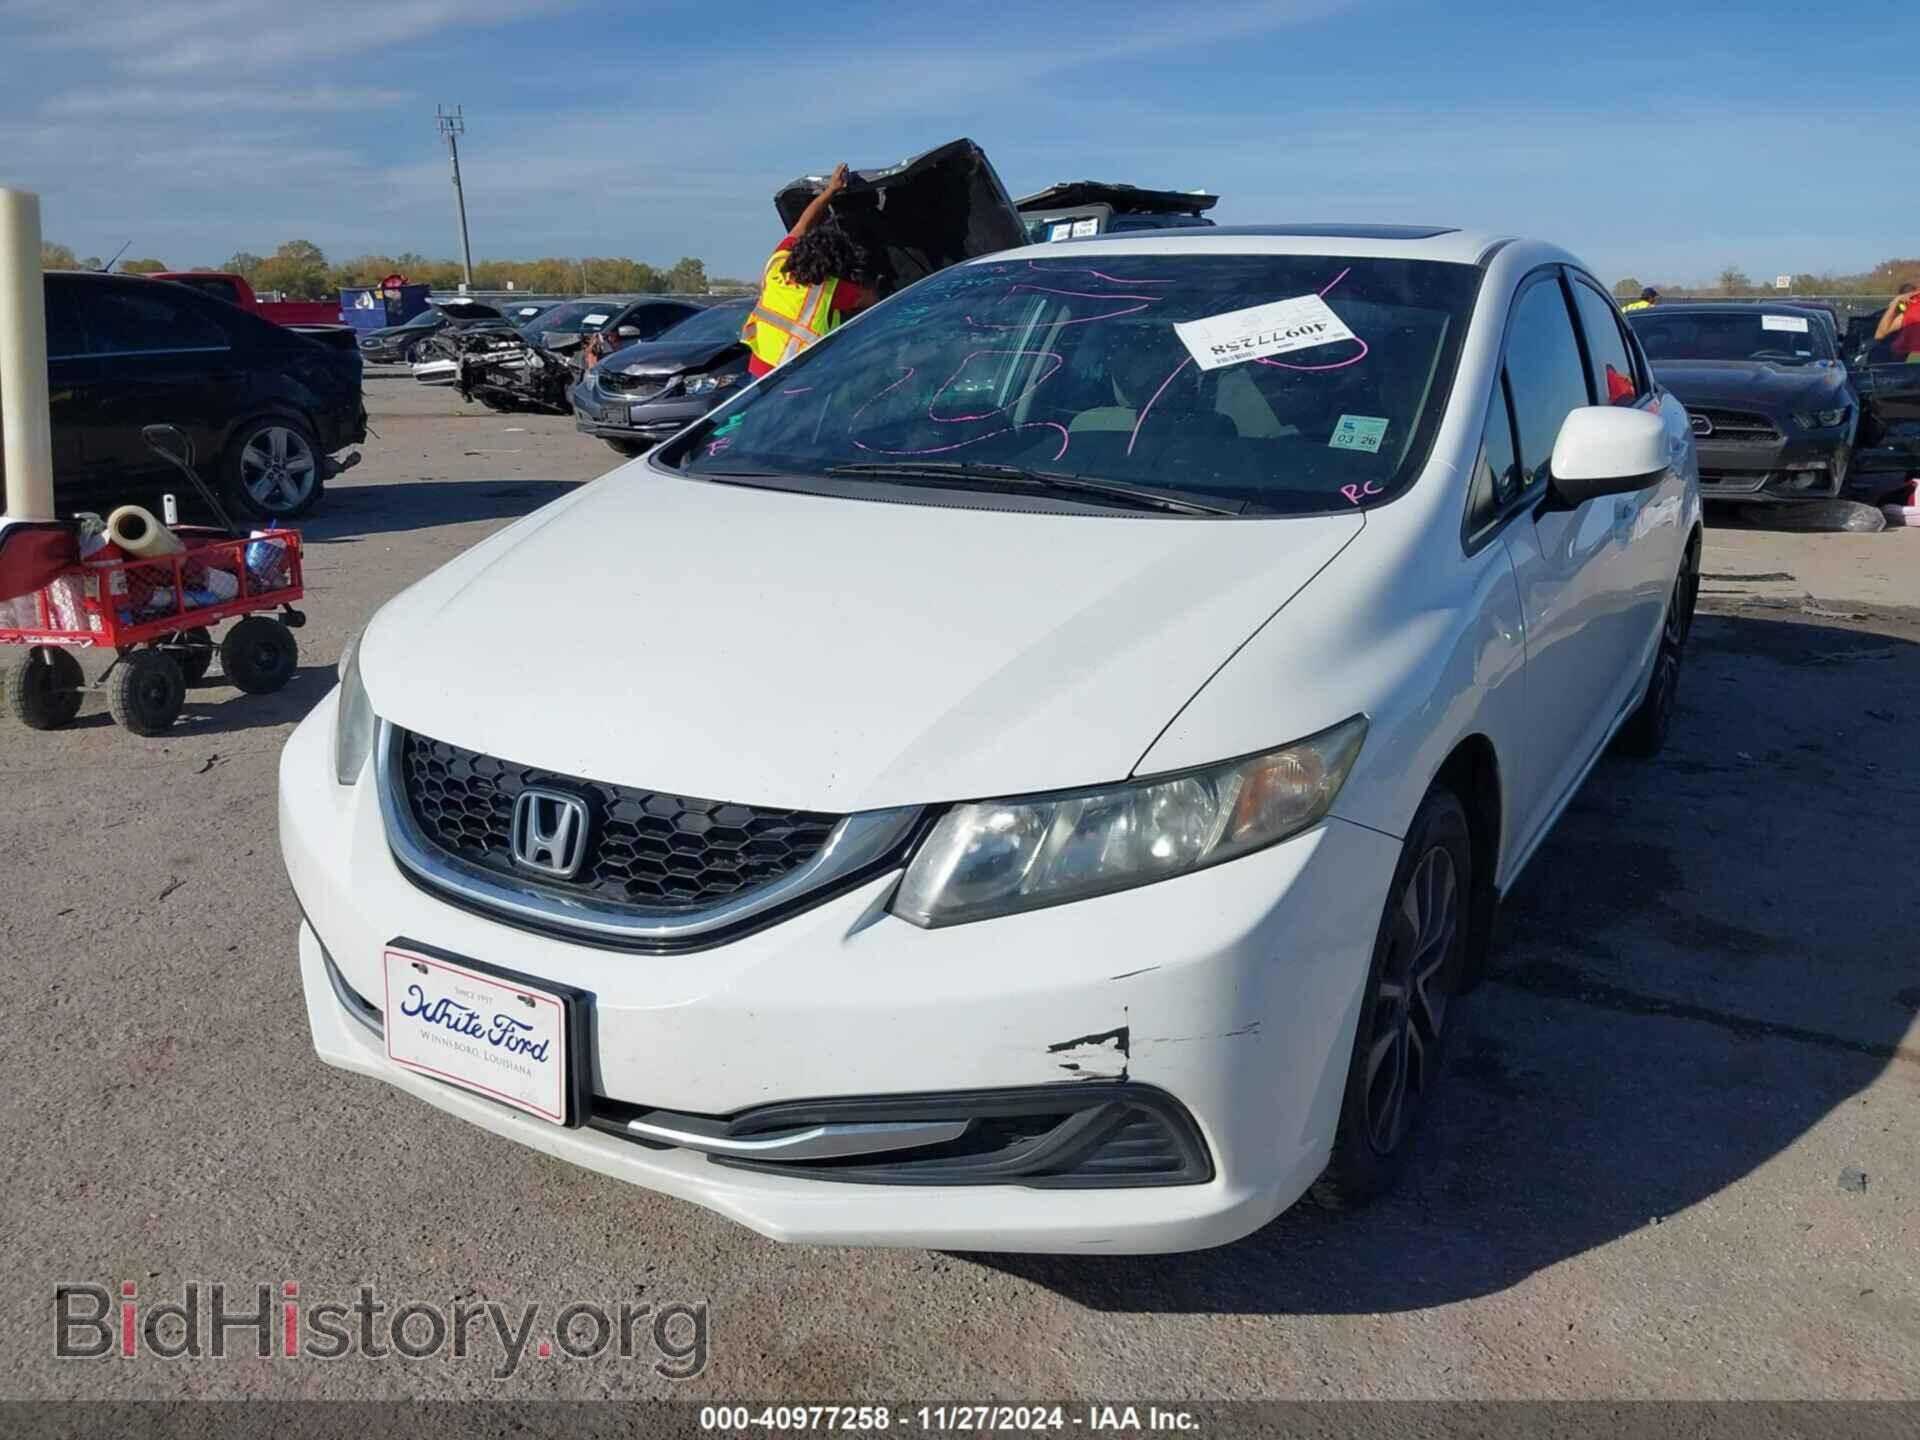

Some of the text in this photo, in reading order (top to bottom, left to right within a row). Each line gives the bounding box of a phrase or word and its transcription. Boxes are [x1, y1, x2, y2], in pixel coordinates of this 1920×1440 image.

[1210, 321, 1328, 356] 40977258
[1337, 434, 1377, 446] 03 26
[401, 984, 549, 1063] White Ford
[484, 1051, 532, 1078] LOUISIANA
